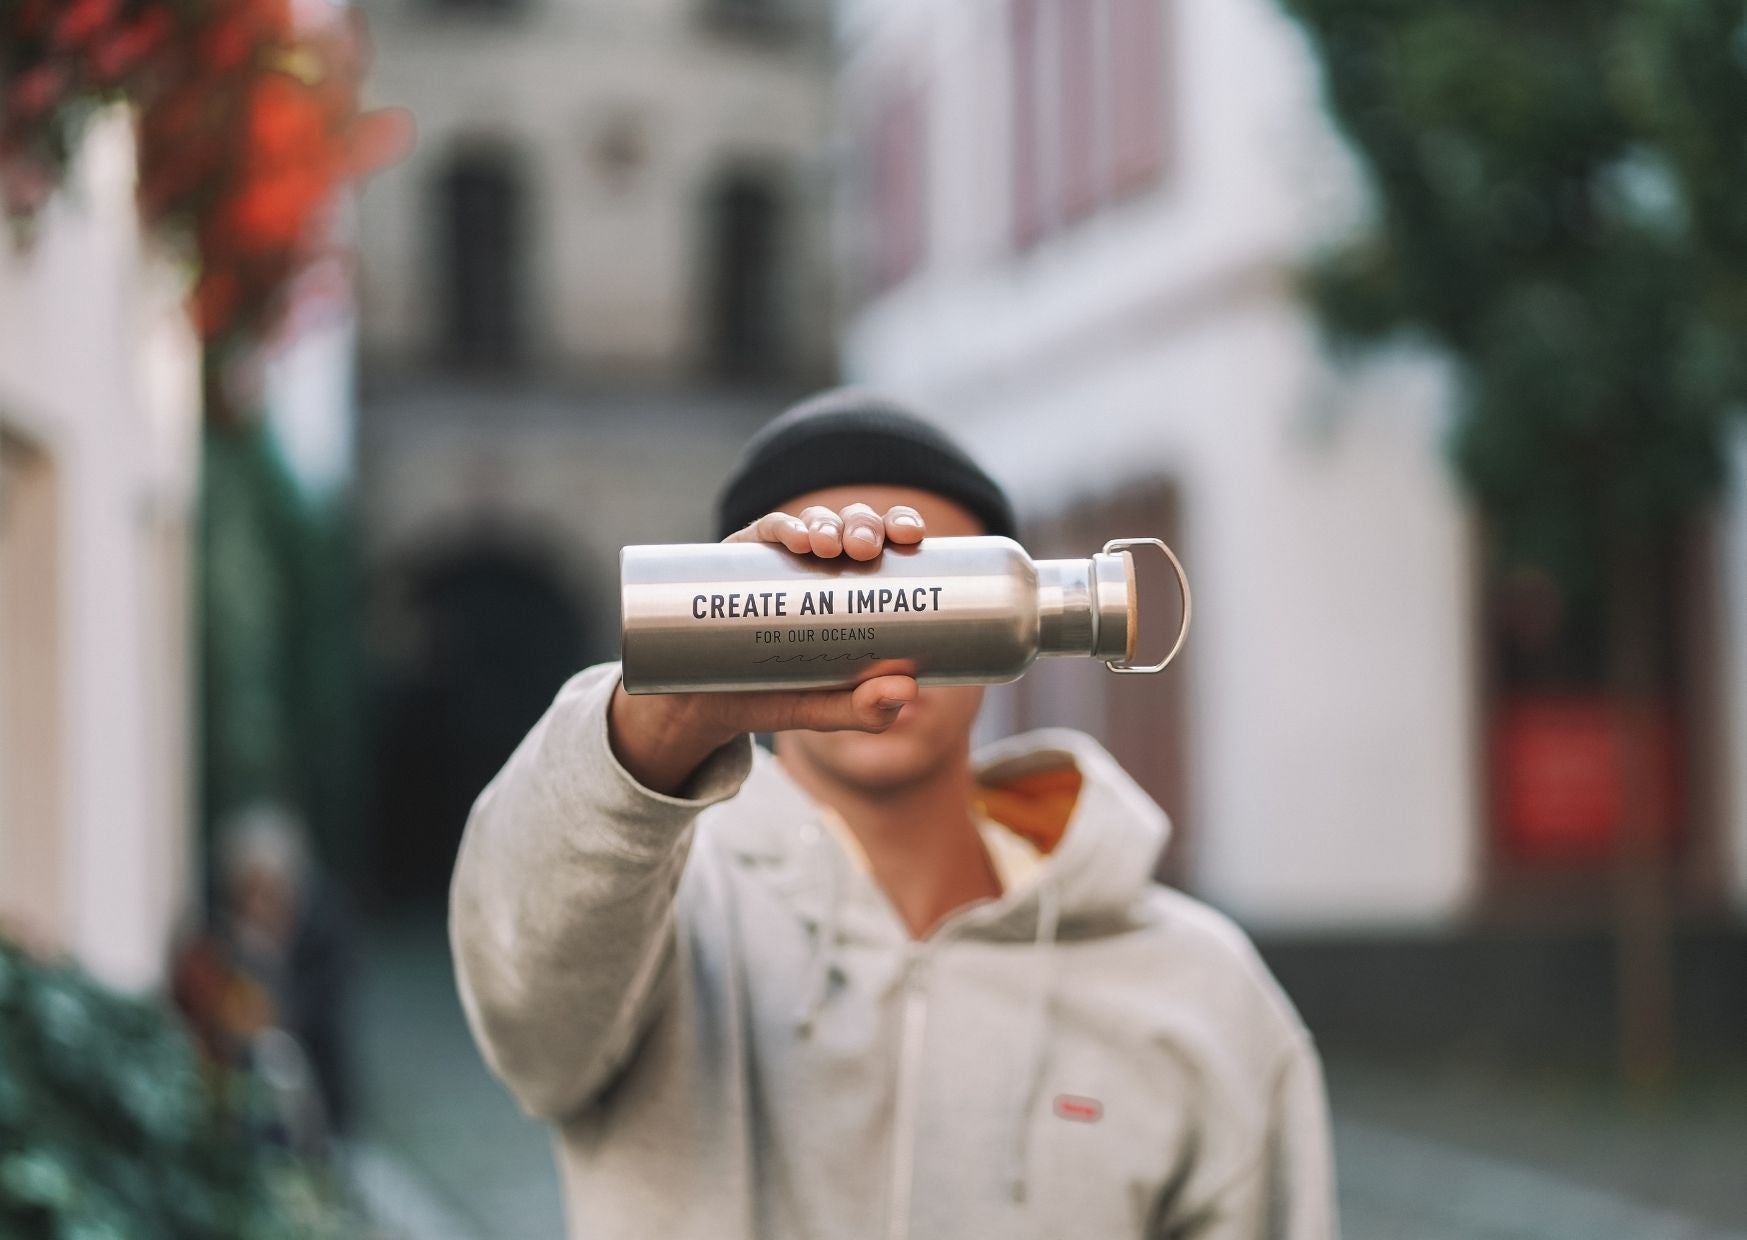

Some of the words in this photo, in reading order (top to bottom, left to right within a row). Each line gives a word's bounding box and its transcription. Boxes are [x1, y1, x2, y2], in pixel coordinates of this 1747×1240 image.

[692, 592, 787, 619] CREATE
[800, 590, 834, 616] AN
[848, 587, 943, 614] IMPACT
[755, 631, 781, 644] FOR
[788, 629, 815, 643] OUR
[822, 627, 876, 642] OCEANS
